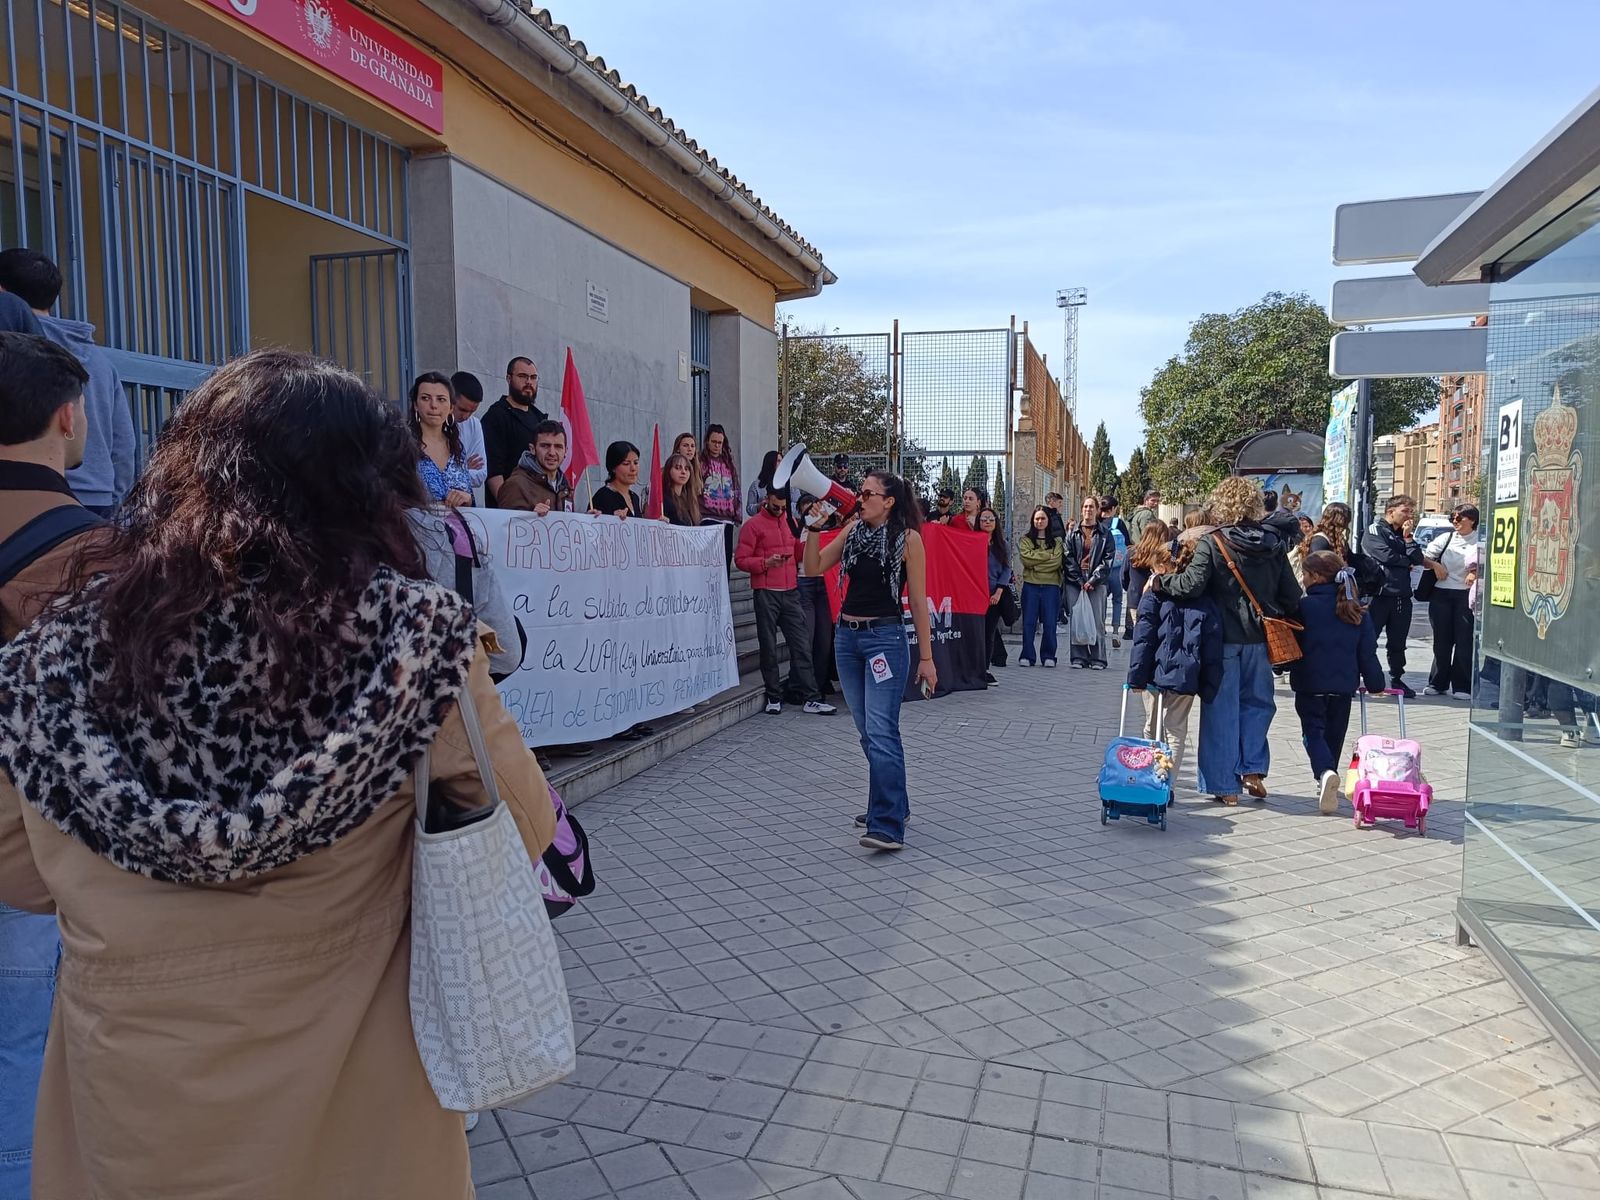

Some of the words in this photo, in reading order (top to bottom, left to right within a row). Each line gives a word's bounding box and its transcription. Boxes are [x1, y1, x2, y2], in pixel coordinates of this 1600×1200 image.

[349, 25, 434, 89] UNIVERSIDAD
[350, 48, 369, 69] DE
[369, 58, 434, 109] GRANADA
[1499, 409, 1520, 452] B1
[1493, 517, 1516, 554] B2
[513, 594, 535, 613] a
[547, 584, 573, 618] la
[542, 639, 566, 671] la
[562, 689, 588, 728] de
